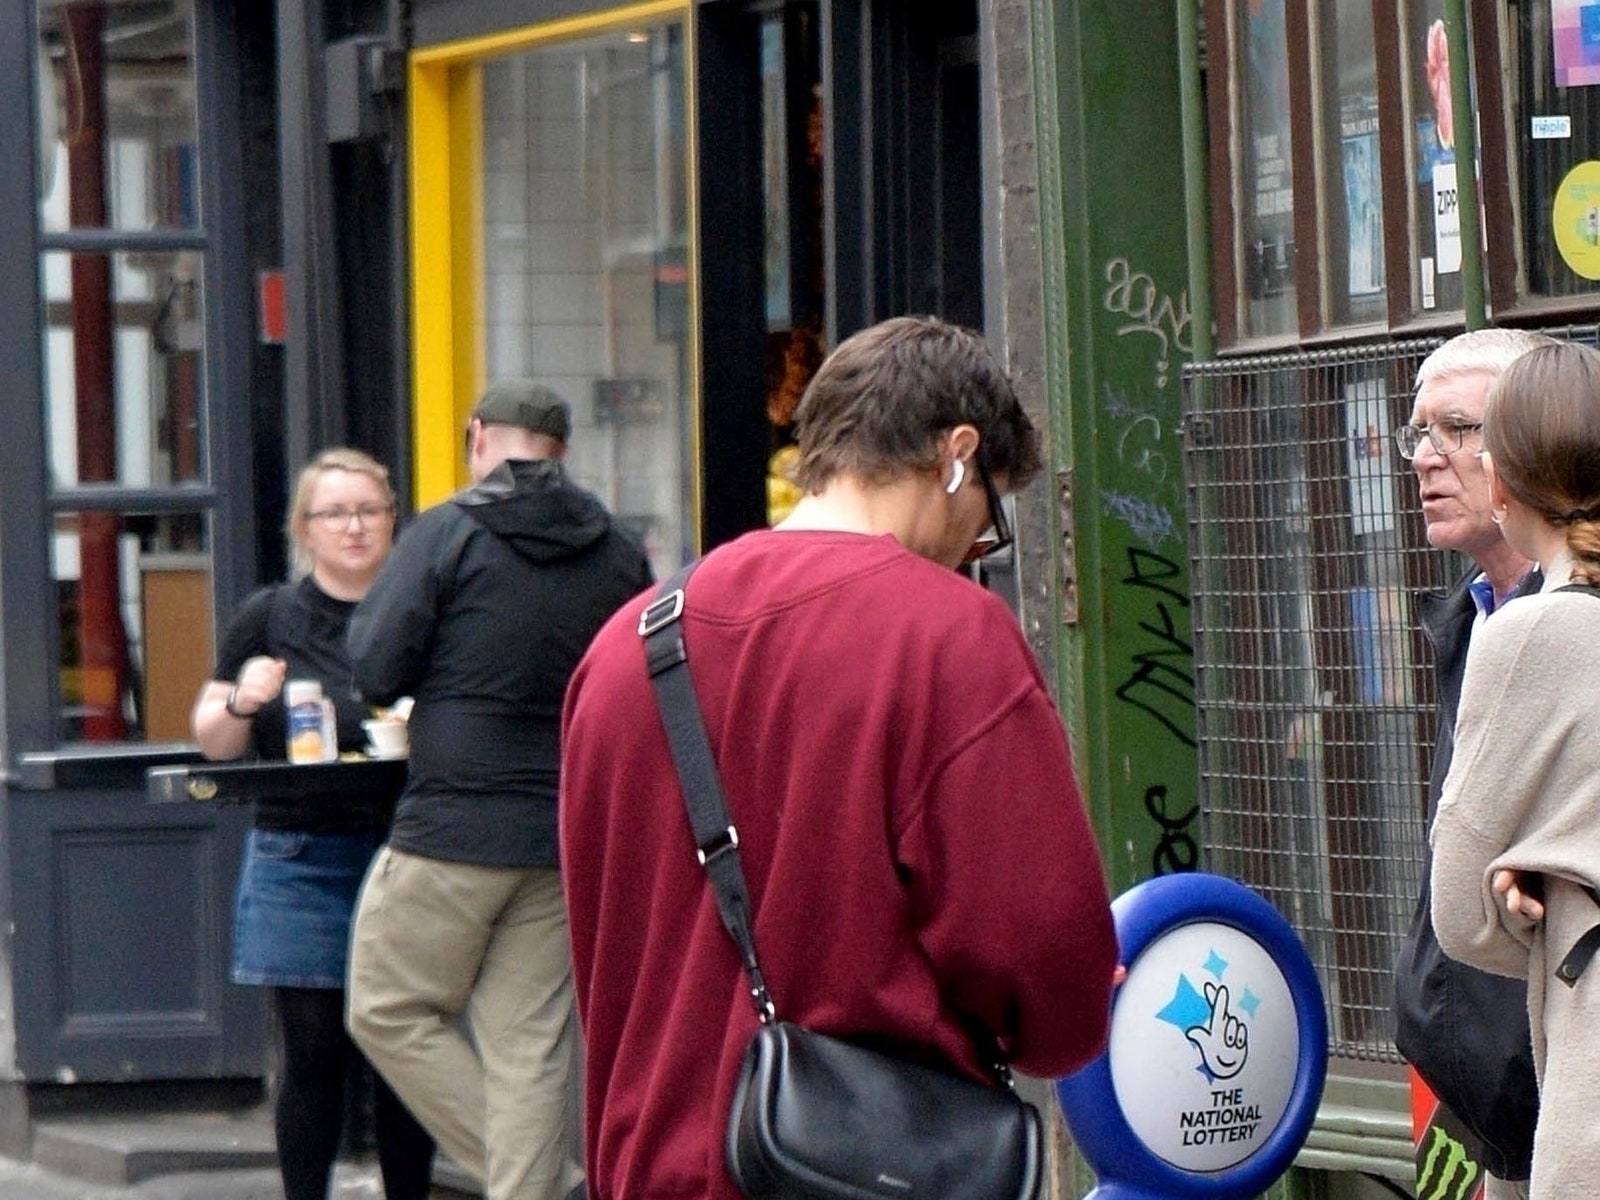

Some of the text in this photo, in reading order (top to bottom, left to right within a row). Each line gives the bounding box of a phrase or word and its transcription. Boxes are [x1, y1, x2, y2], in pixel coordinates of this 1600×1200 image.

[1211, 1088, 1243, 1107] THE
[1180, 1105, 1262, 1128] NATIONAL
[1183, 1123, 1257, 1146] LOTTERY
